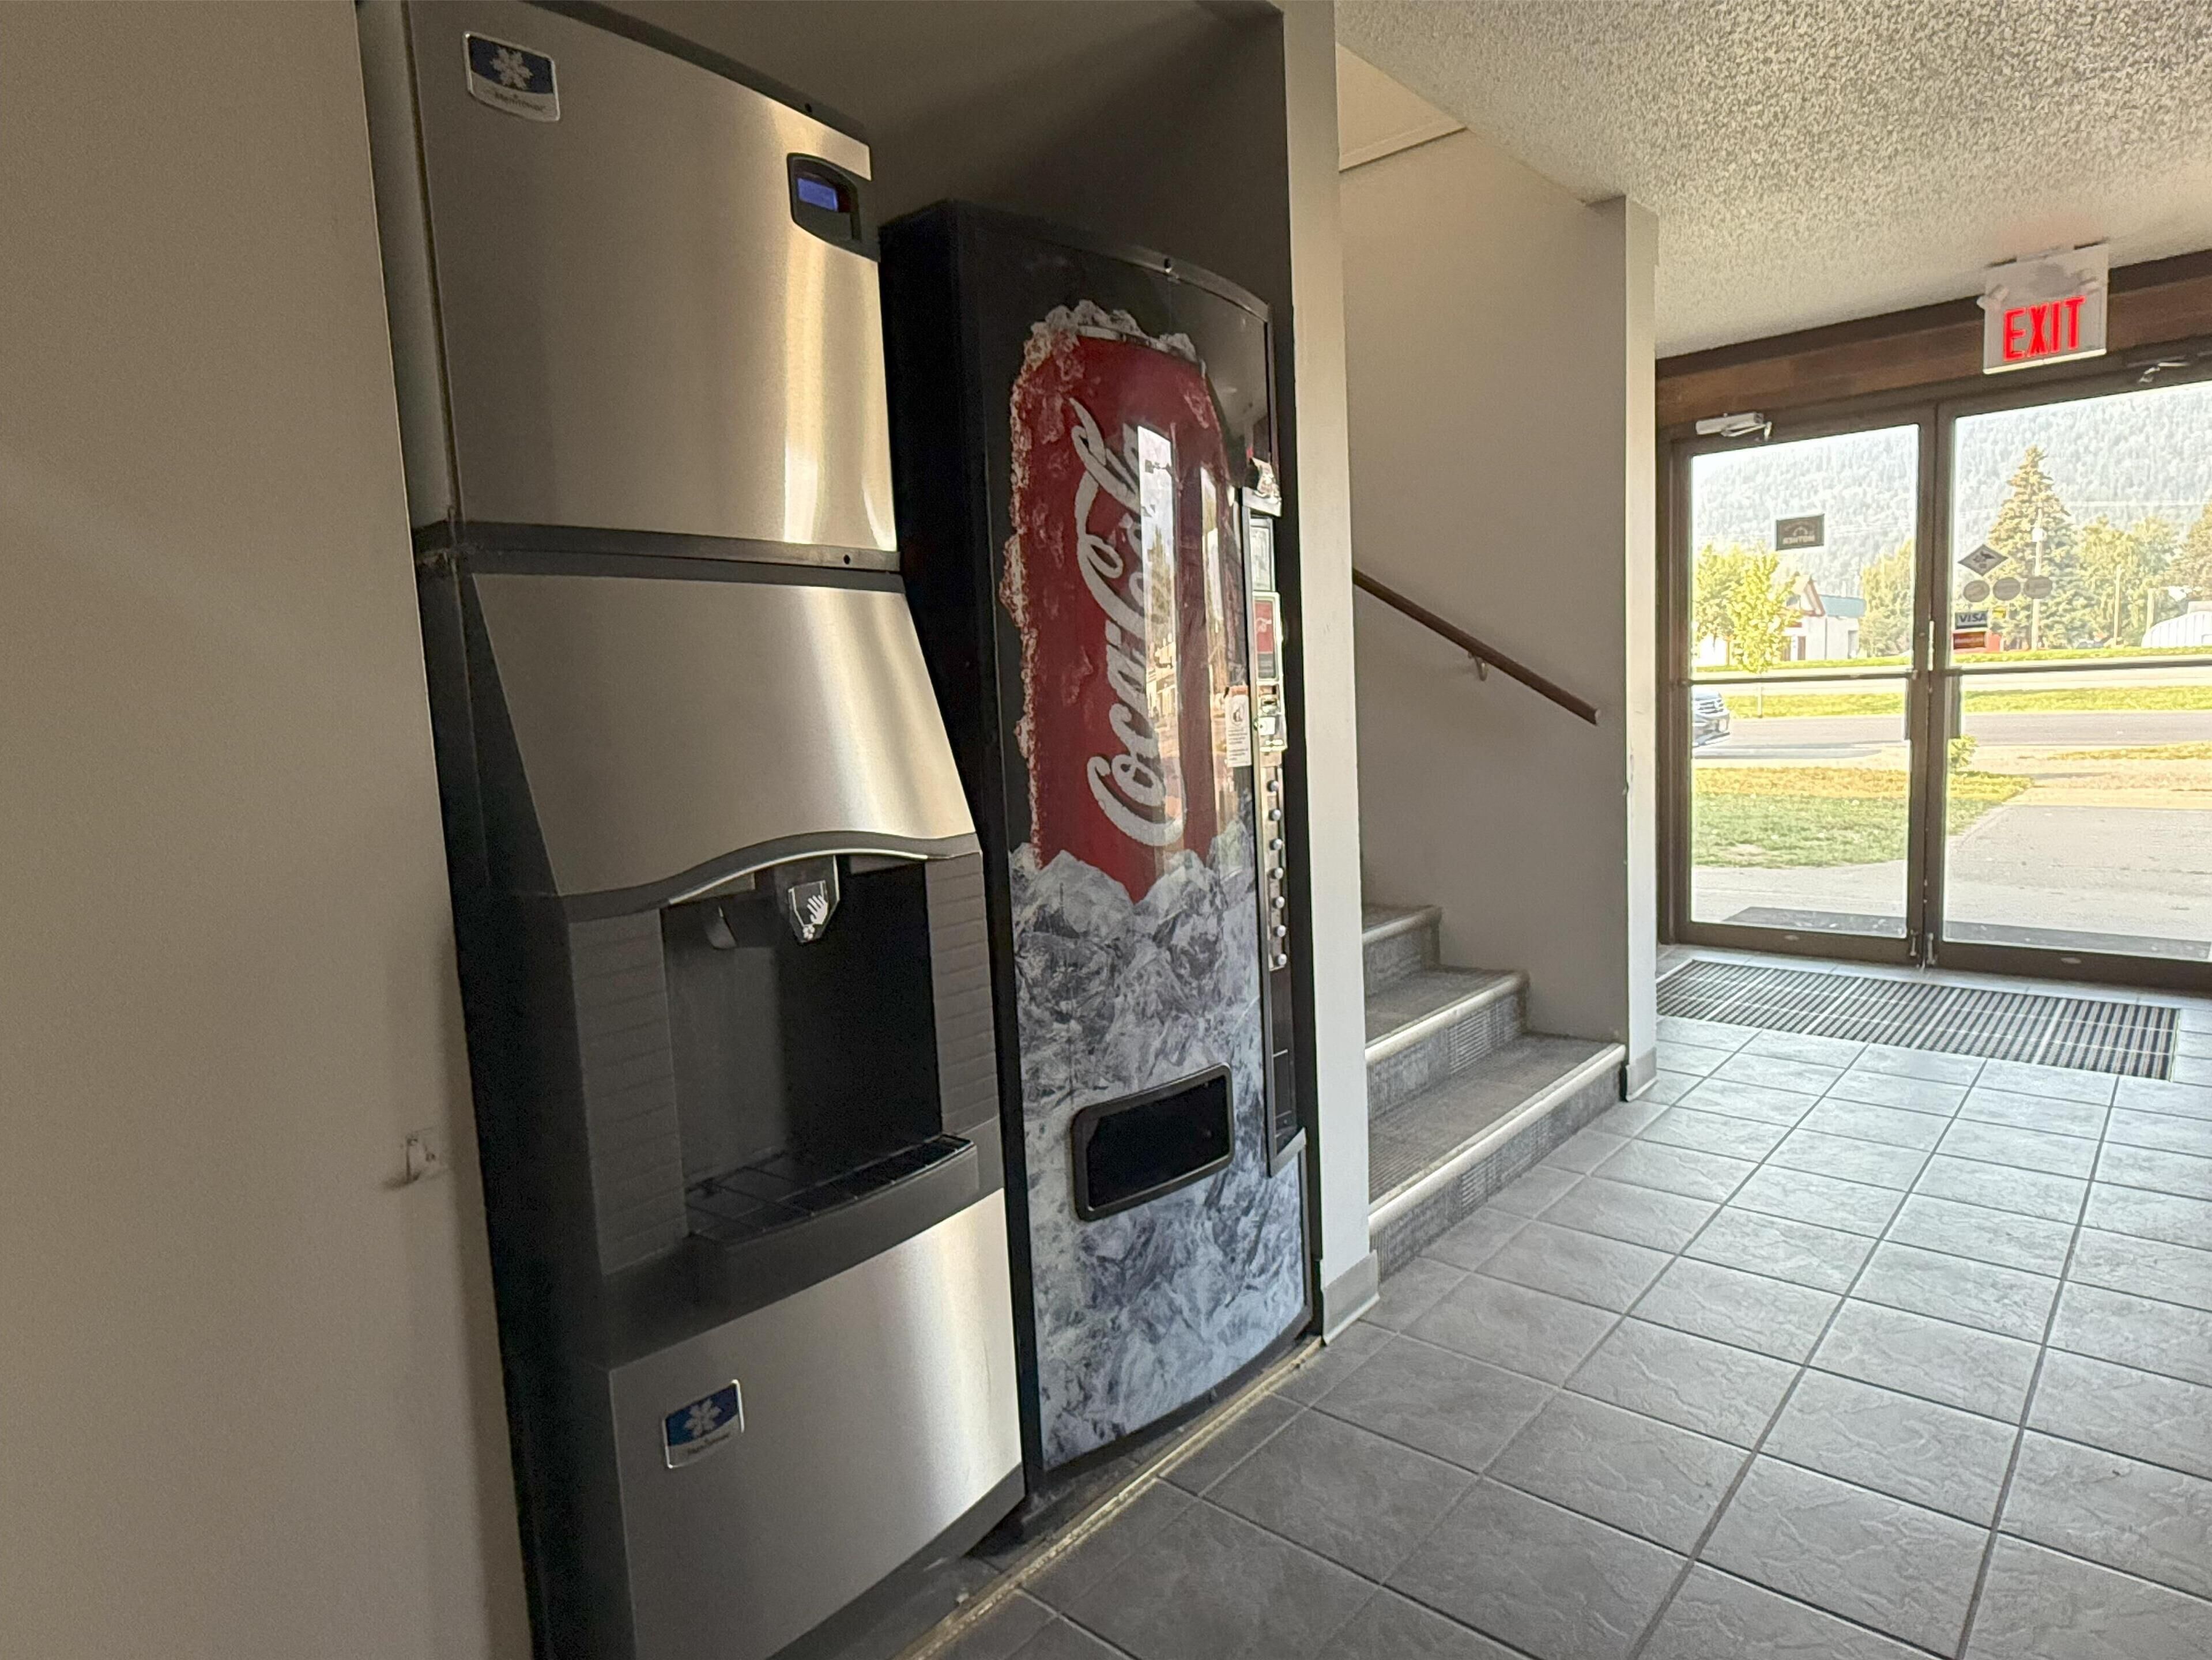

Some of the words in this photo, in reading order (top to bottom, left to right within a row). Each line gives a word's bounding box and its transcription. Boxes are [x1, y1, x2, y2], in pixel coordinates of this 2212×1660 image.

[2004, 296, 2086, 361] EXIT
[1069, 397, 1186, 847] Coca-Cola
[1959, 612, 1988, 623] VISA
